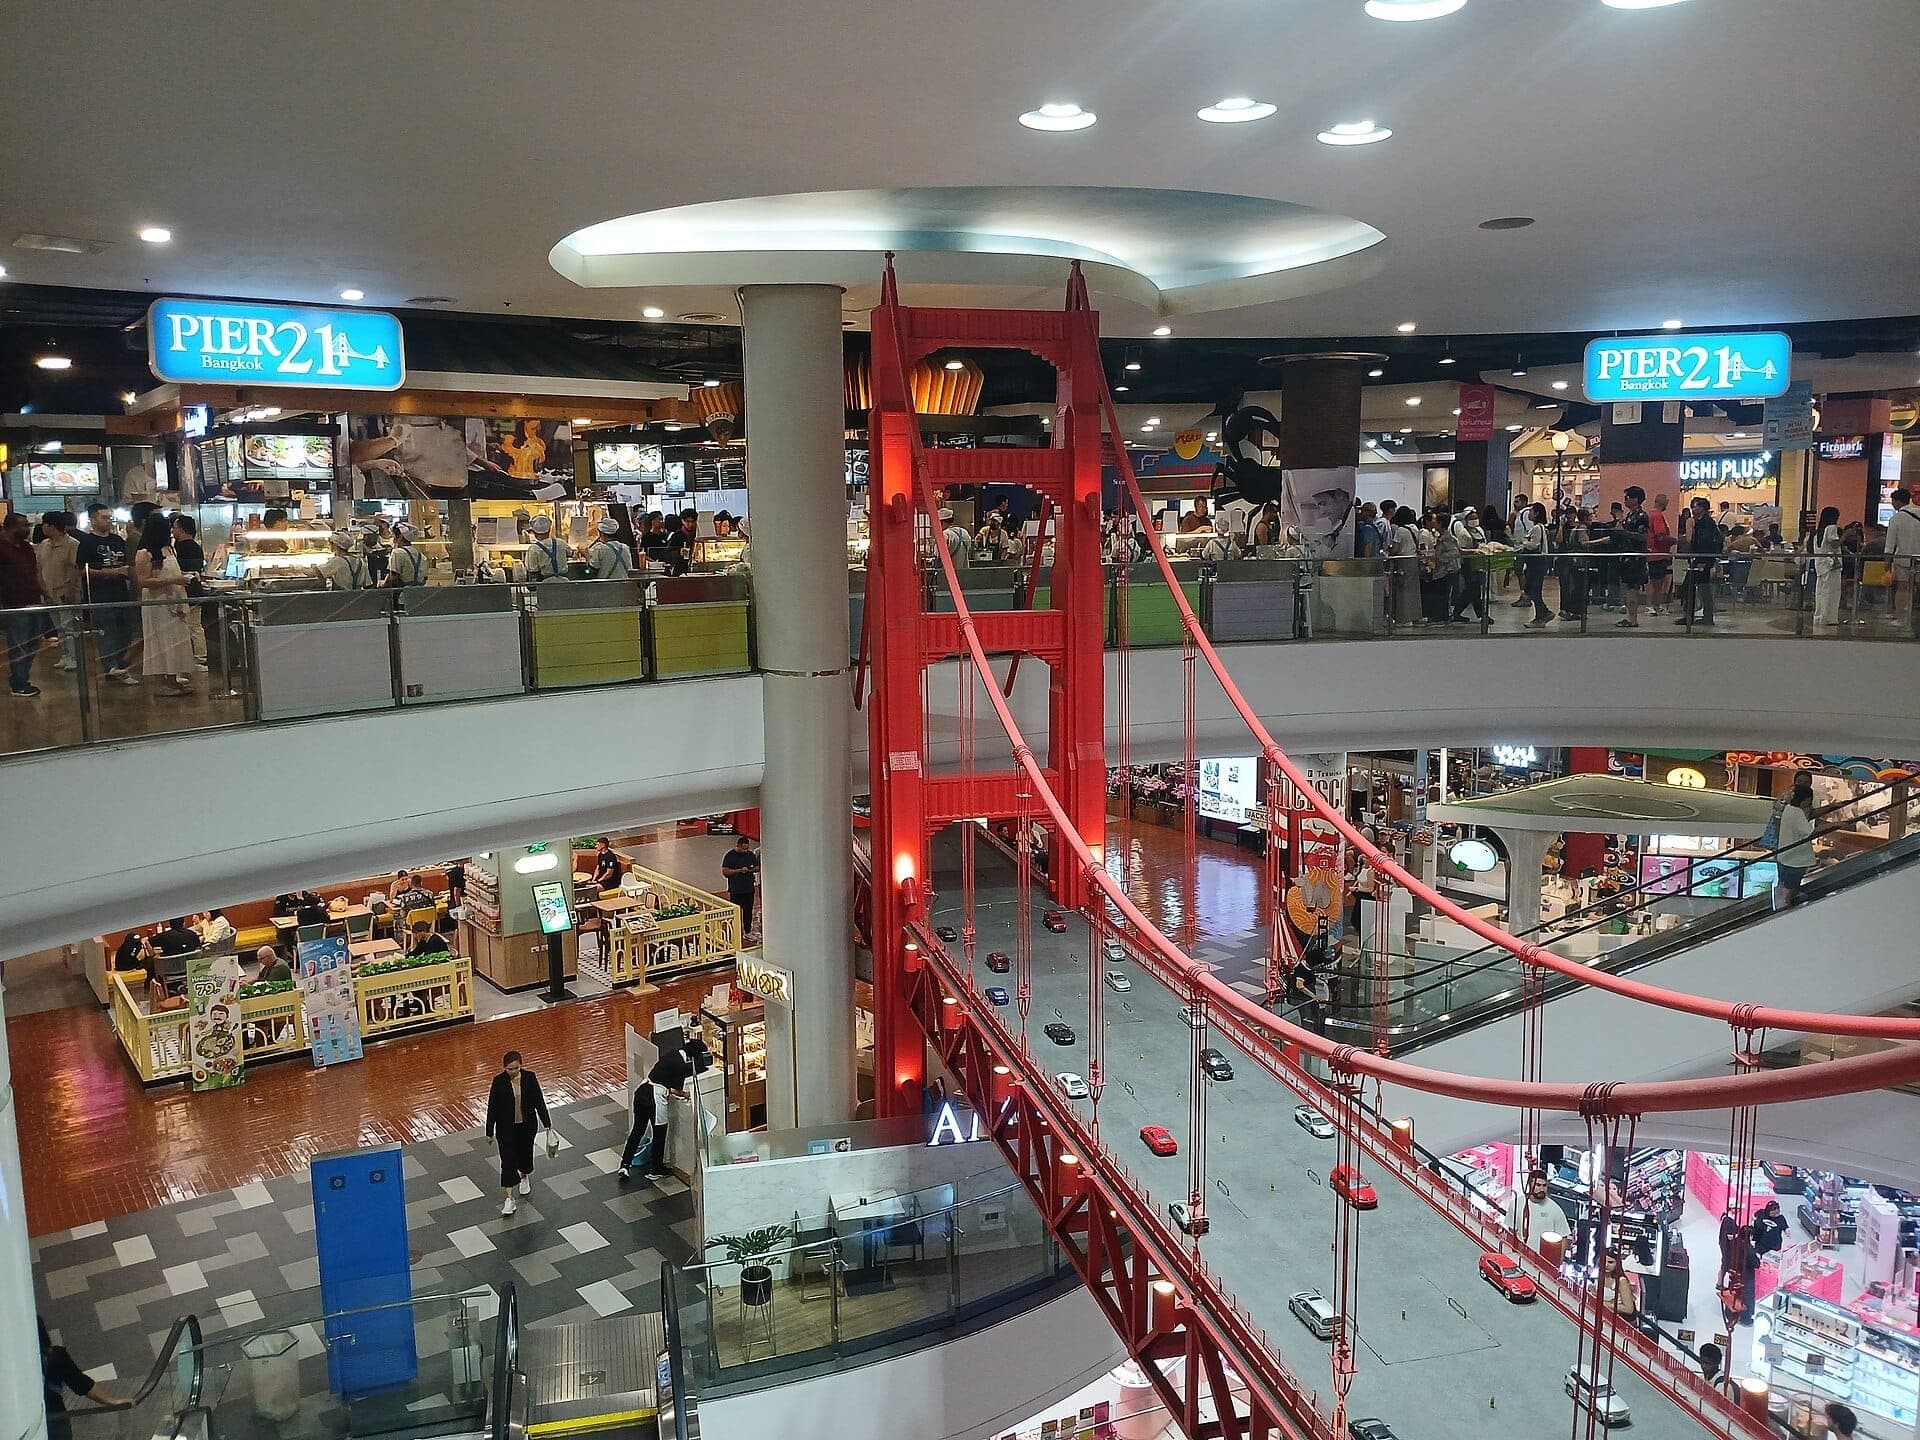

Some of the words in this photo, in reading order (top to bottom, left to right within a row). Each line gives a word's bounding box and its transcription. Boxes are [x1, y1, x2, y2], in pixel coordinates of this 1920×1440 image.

[201, 354, 264, 372] Bangkok
[1620, 379, 1670, 392] Bangkok
[1680, 460, 1717, 480] USHi
[1721, 458, 1765, 480] PLUS
